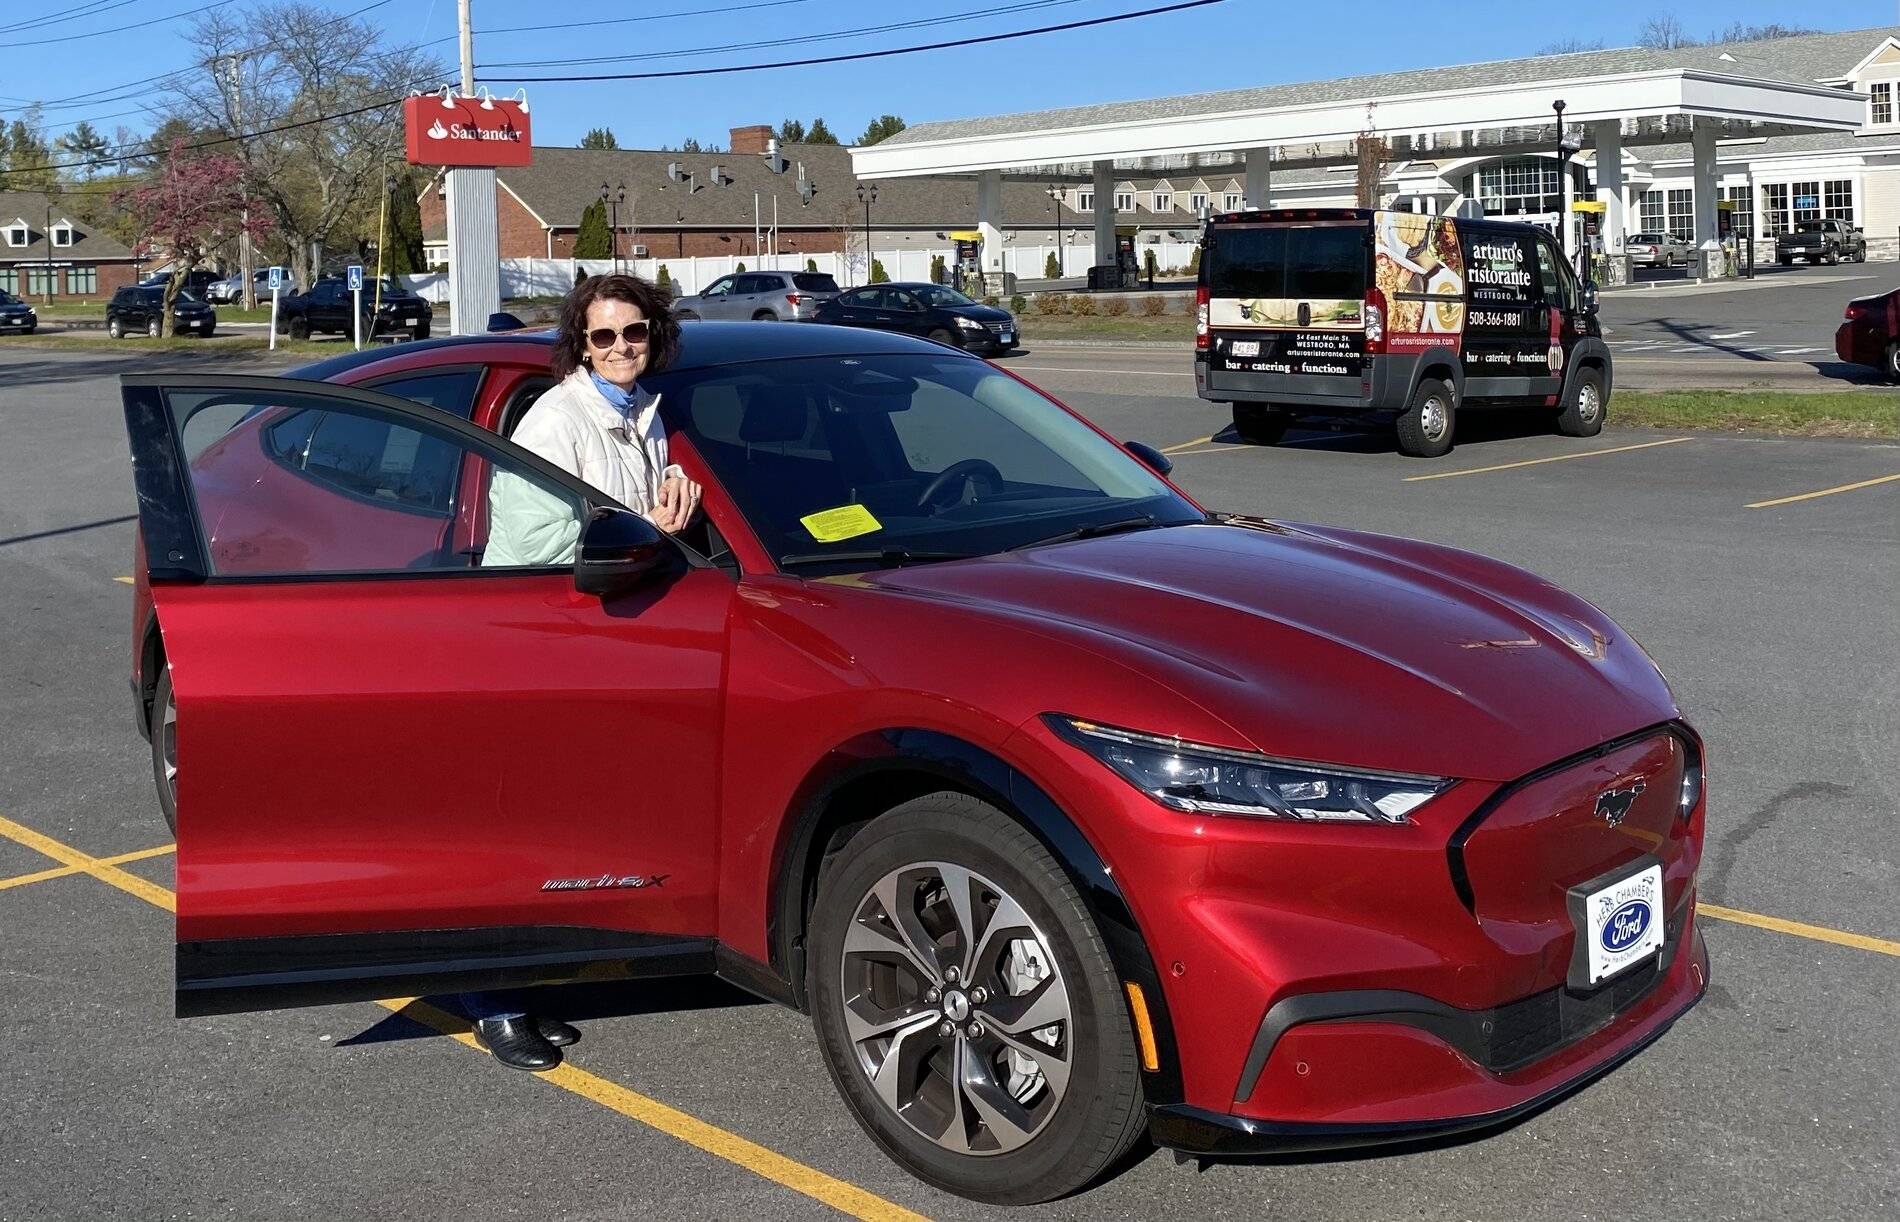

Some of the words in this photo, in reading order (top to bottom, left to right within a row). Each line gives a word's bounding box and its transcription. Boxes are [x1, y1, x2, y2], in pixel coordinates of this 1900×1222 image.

[450, 123, 522, 141] Santander
[1473, 242, 1523, 262] arturo's
[1468, 262, 1531, 286] ristorante
[1473, 291, 1514, 301] WESTBORO,
[1469, 311, 1521, 326] 508-366-1881
[1296, 341, 1336, 350] WESTBORO,
[1390, 337, 1455, 346] arturosristorante.com
[1287, 350, 1360, 358] arturosristorante.com
[1466, 351, 1479, 363] bar
[1485, 351, 1511, 365] catering
[1516, 351, 1547, 363] functions
[1225, 359, 1241, 369] bar
[1251, 361, 1291, 373] catering
[1301, 362, 1348, 374] functions
[1616, 884, 1654, 904] CHAMBERS
[1612, 907, 1642, 946] Ford
